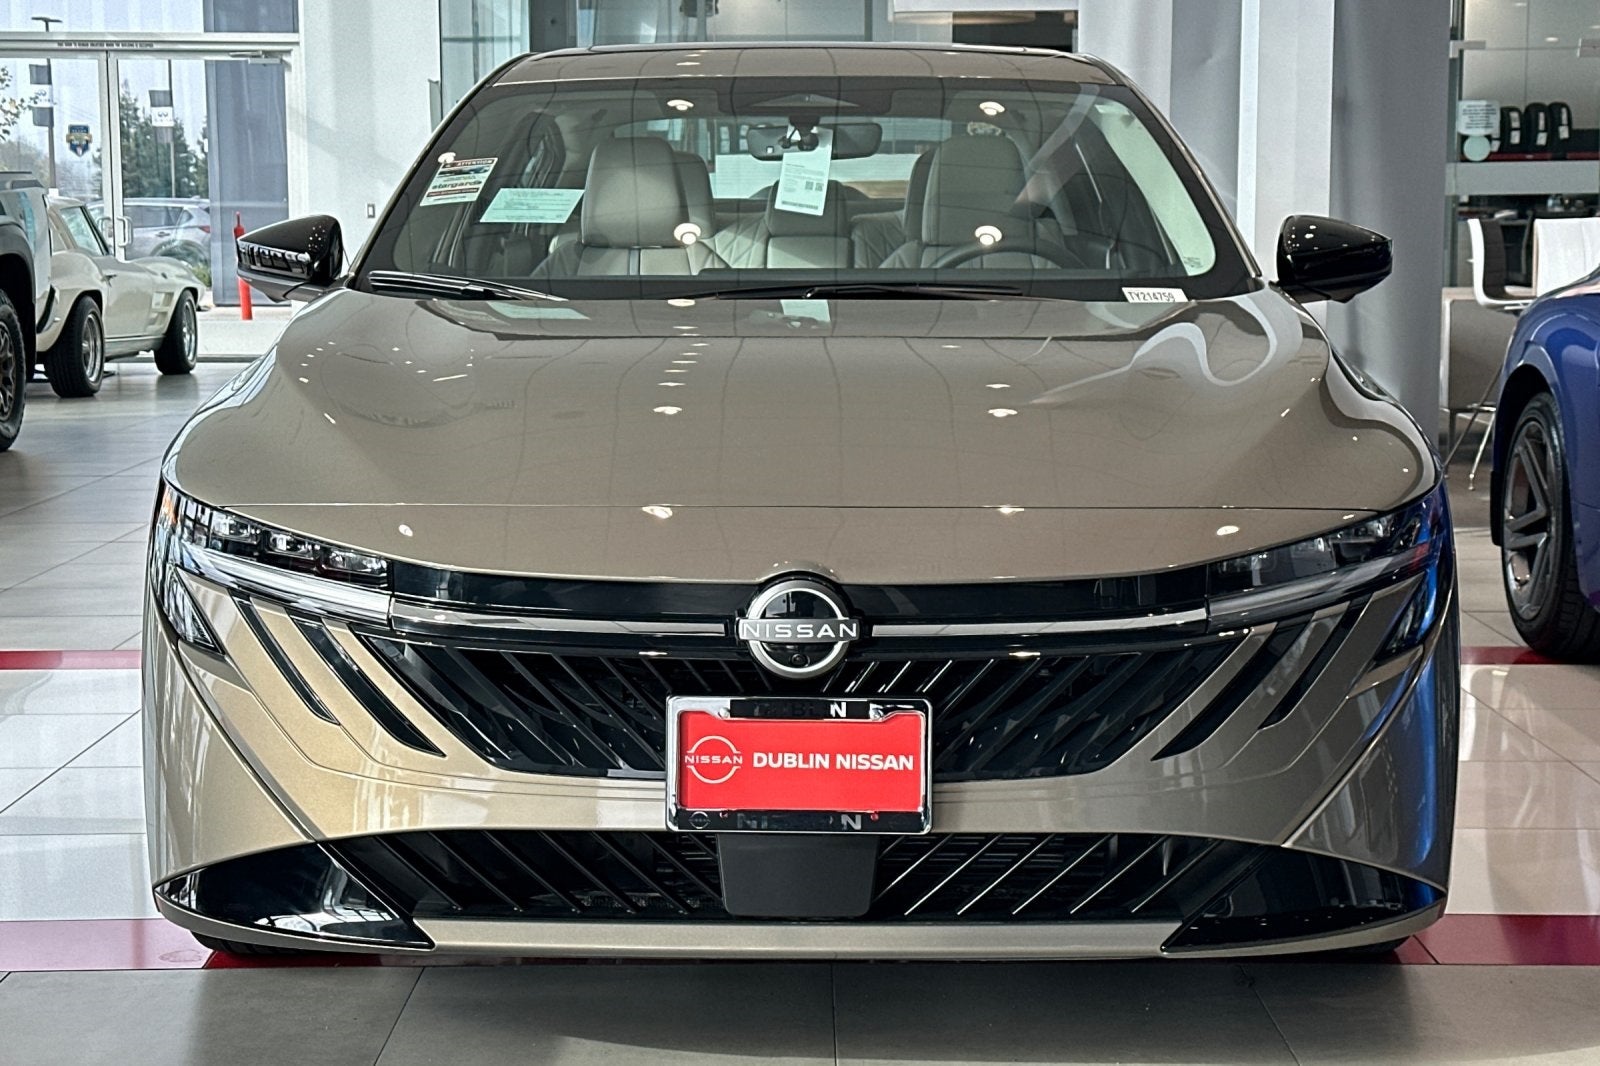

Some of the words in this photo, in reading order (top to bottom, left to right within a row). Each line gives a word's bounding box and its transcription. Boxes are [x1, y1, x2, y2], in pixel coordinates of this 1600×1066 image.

[743, 623, 857, 638] NISSAN
[684, 755, 743, 765] NISSAN
[753, 752, 830, 769] DUBLIN
[835, 754, 914, 771] NISSAN
